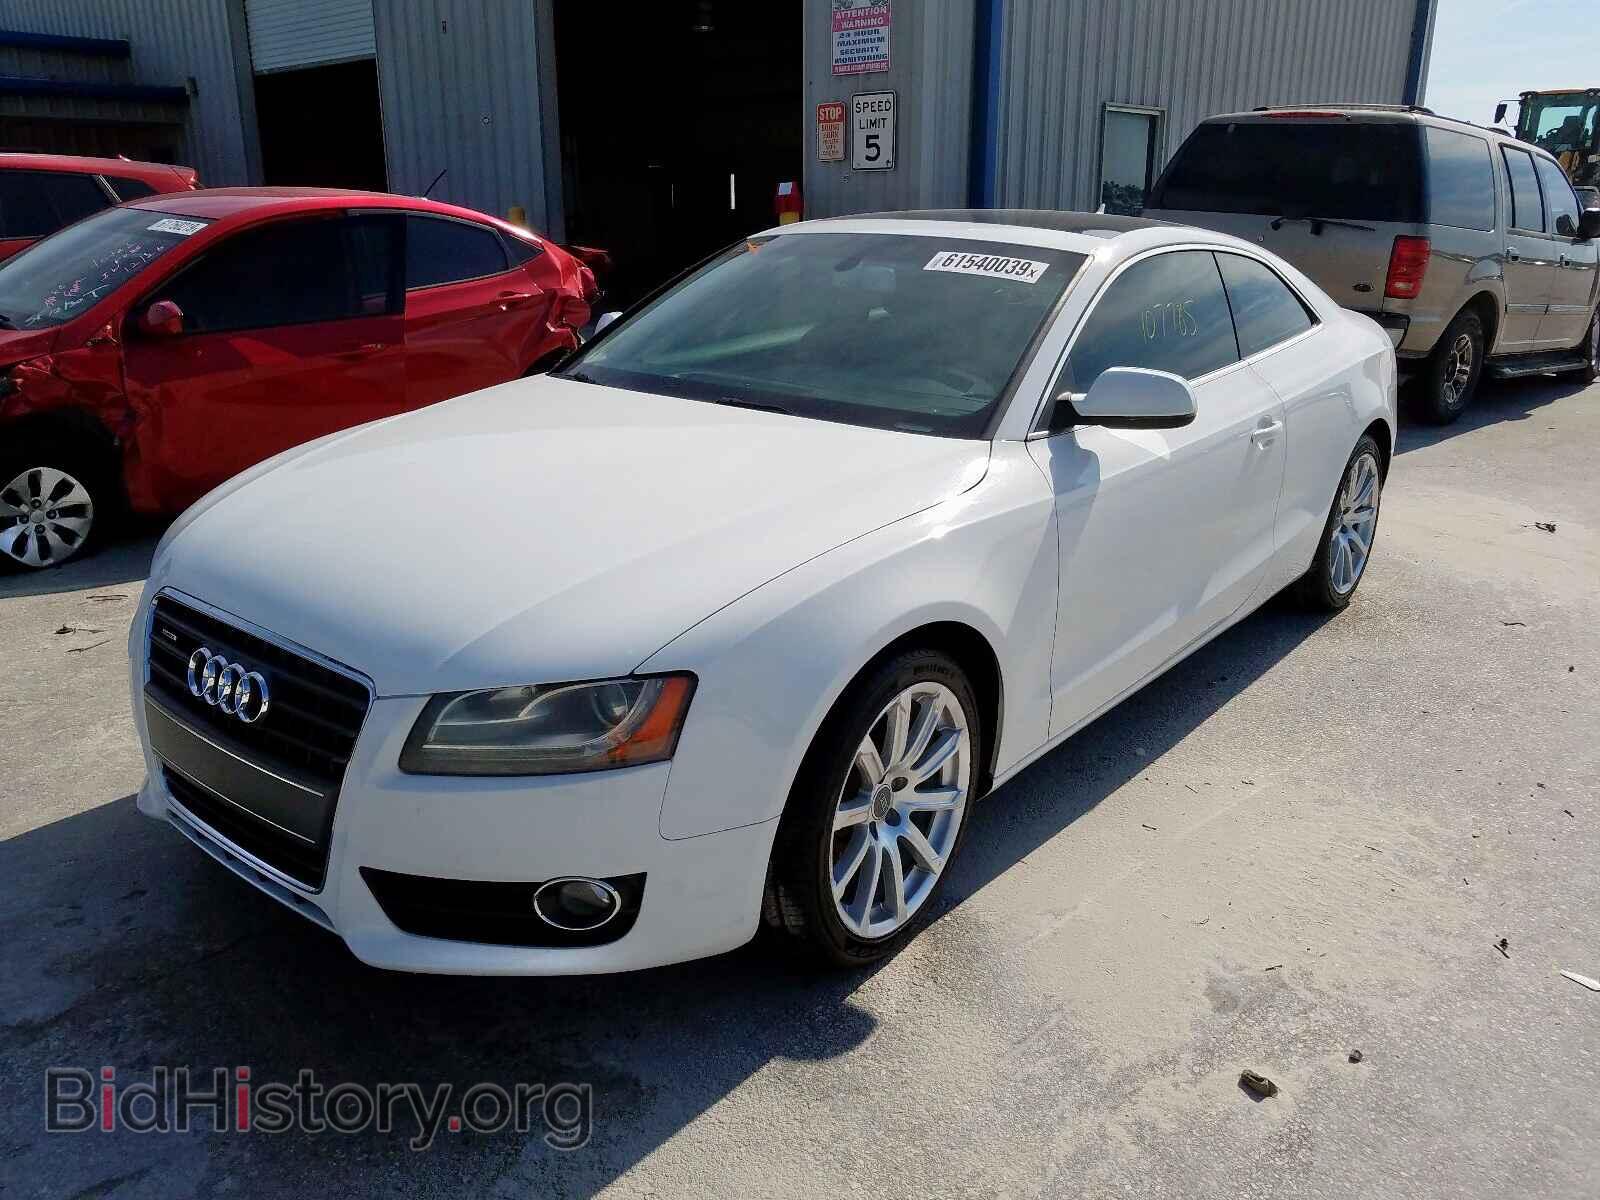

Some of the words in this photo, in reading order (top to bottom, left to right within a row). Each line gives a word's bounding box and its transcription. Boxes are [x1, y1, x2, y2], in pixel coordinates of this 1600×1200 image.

[835, 6, 887, 19] ATTENTION
[841, 16, 884, 30] WARNING
[837, 36, 885, 47] MAXIMUM
[840, 46, 880, 56] SECURITY
[834, 53, 888, 64] MONITORING
[855, 100, 892, 113] SPEED
[819, 107, 842, 121] STOP
[859, 117, 888, 130] LIMIT
[865, 134, 881, 162] 5
